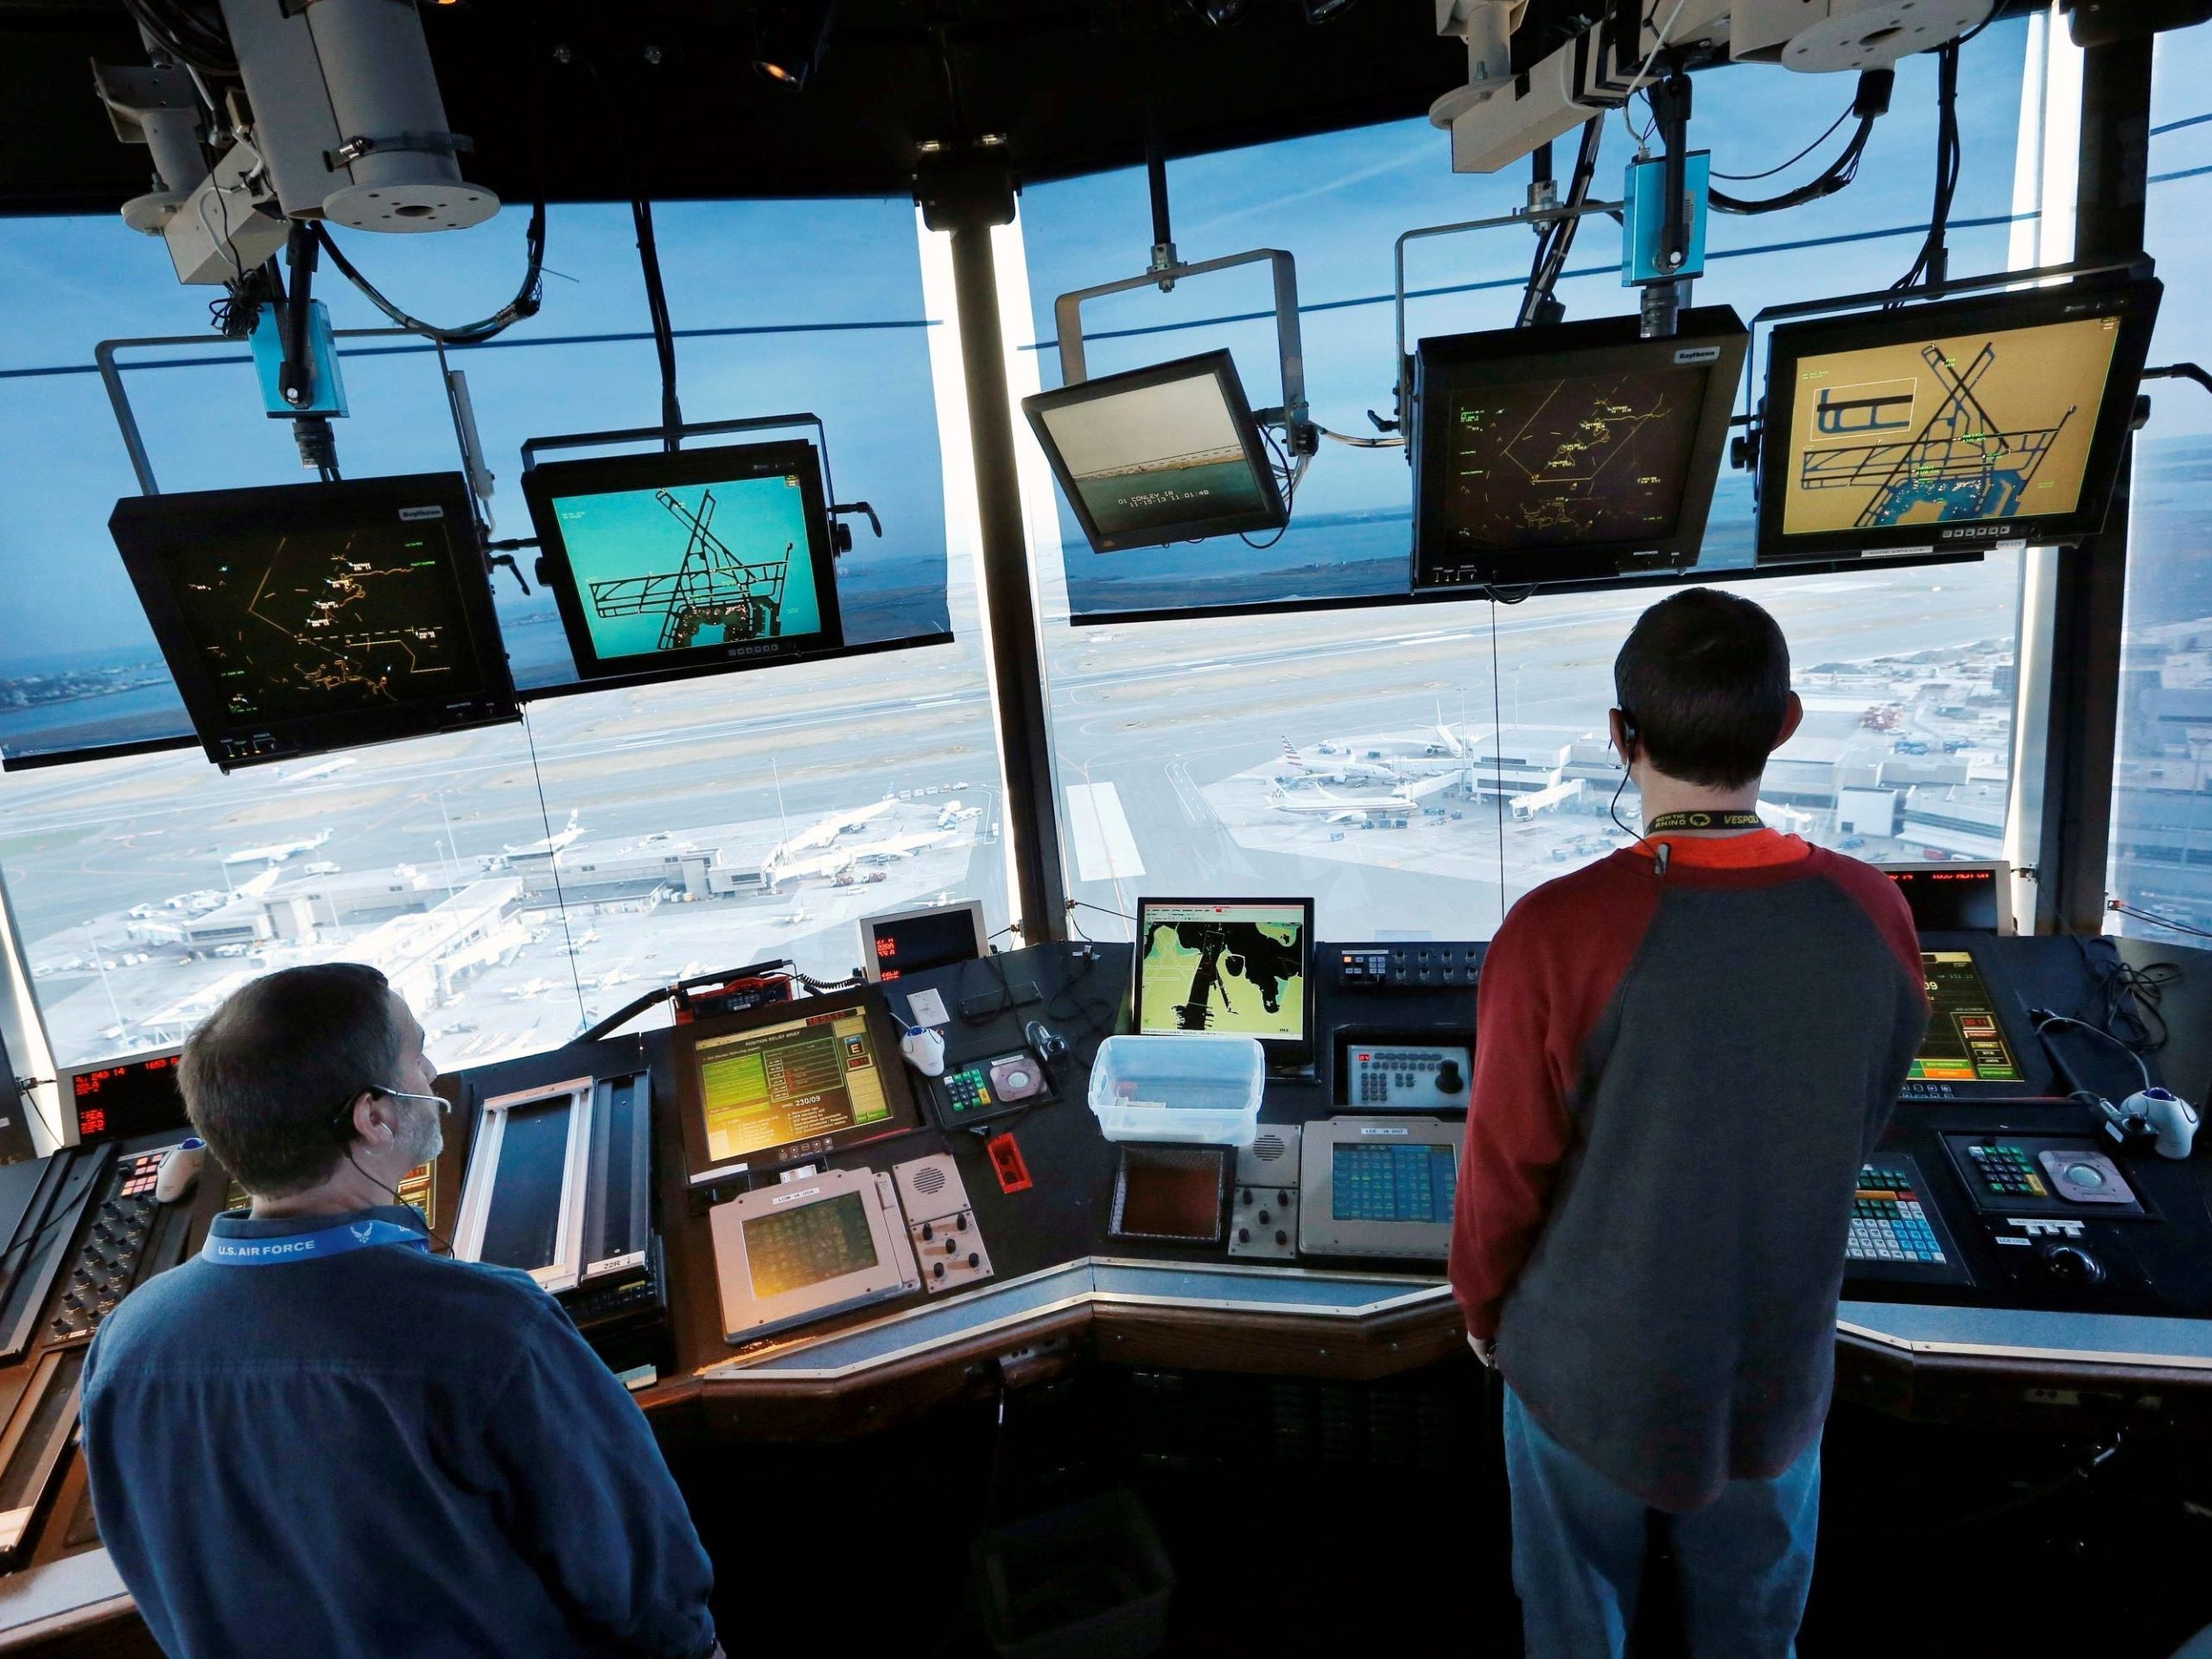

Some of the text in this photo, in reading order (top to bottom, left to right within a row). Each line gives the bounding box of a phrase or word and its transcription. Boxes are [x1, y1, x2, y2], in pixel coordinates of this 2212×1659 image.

[850, 1043, 861, 1053] E
[794, 1095, 821, 1107] 230/09
[218, 1240, 315, 1256] U.S. AIR FORCE
[603, 1260, 620, 1269] 22R
